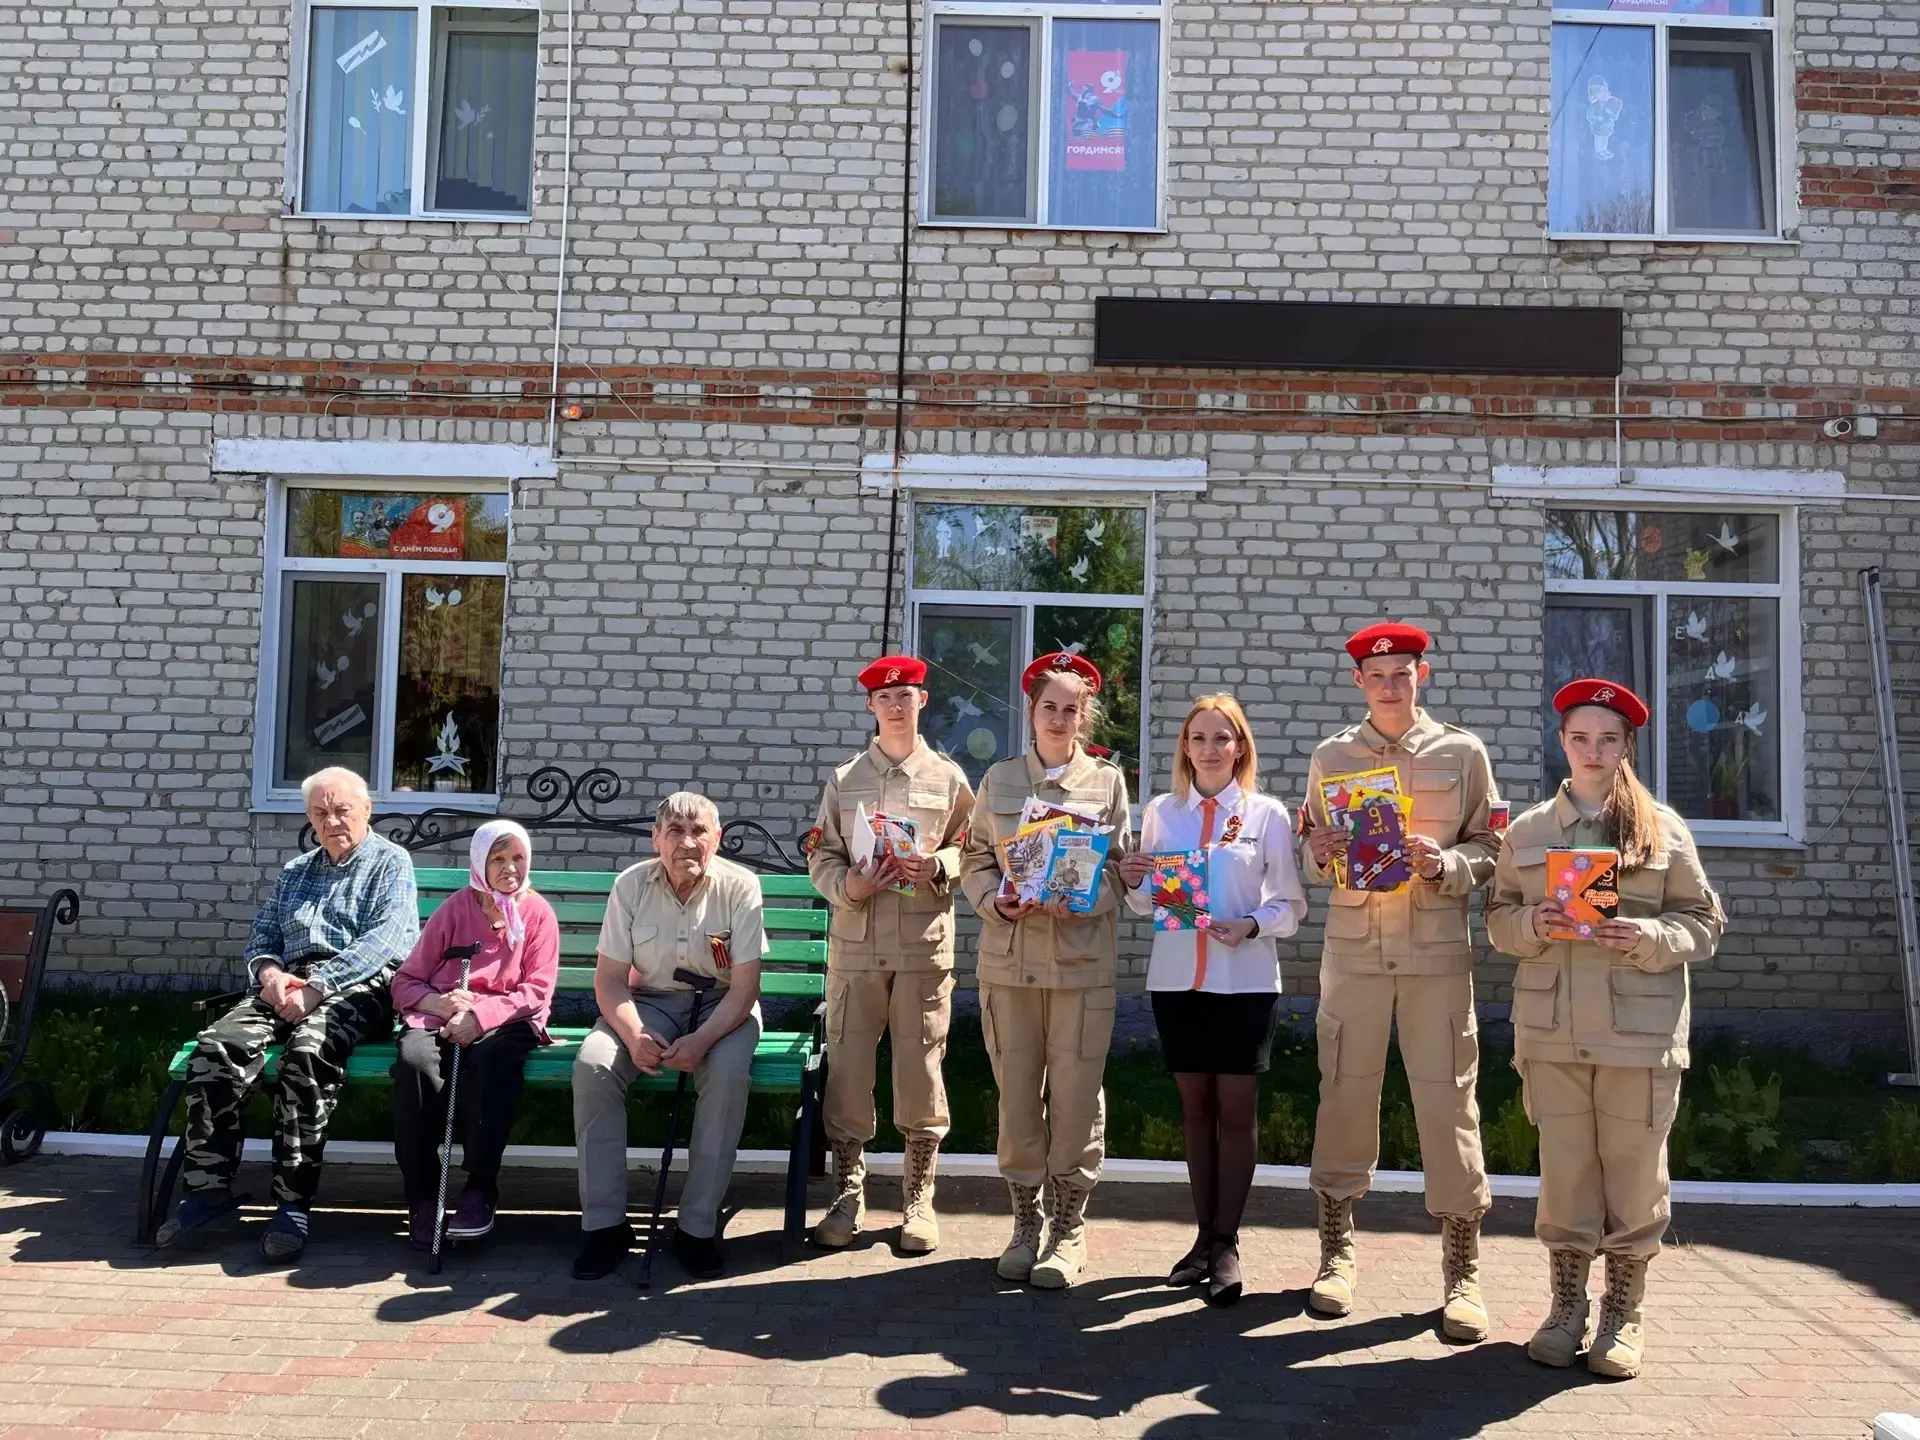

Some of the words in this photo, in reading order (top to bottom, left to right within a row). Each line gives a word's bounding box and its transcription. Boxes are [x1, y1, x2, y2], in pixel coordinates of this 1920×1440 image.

[1067, 146, 1125, 155] ГОРДИМСЯ!
[1369, 807, 1382, 827] 9
[1603, 869, 1614, 881] 9
